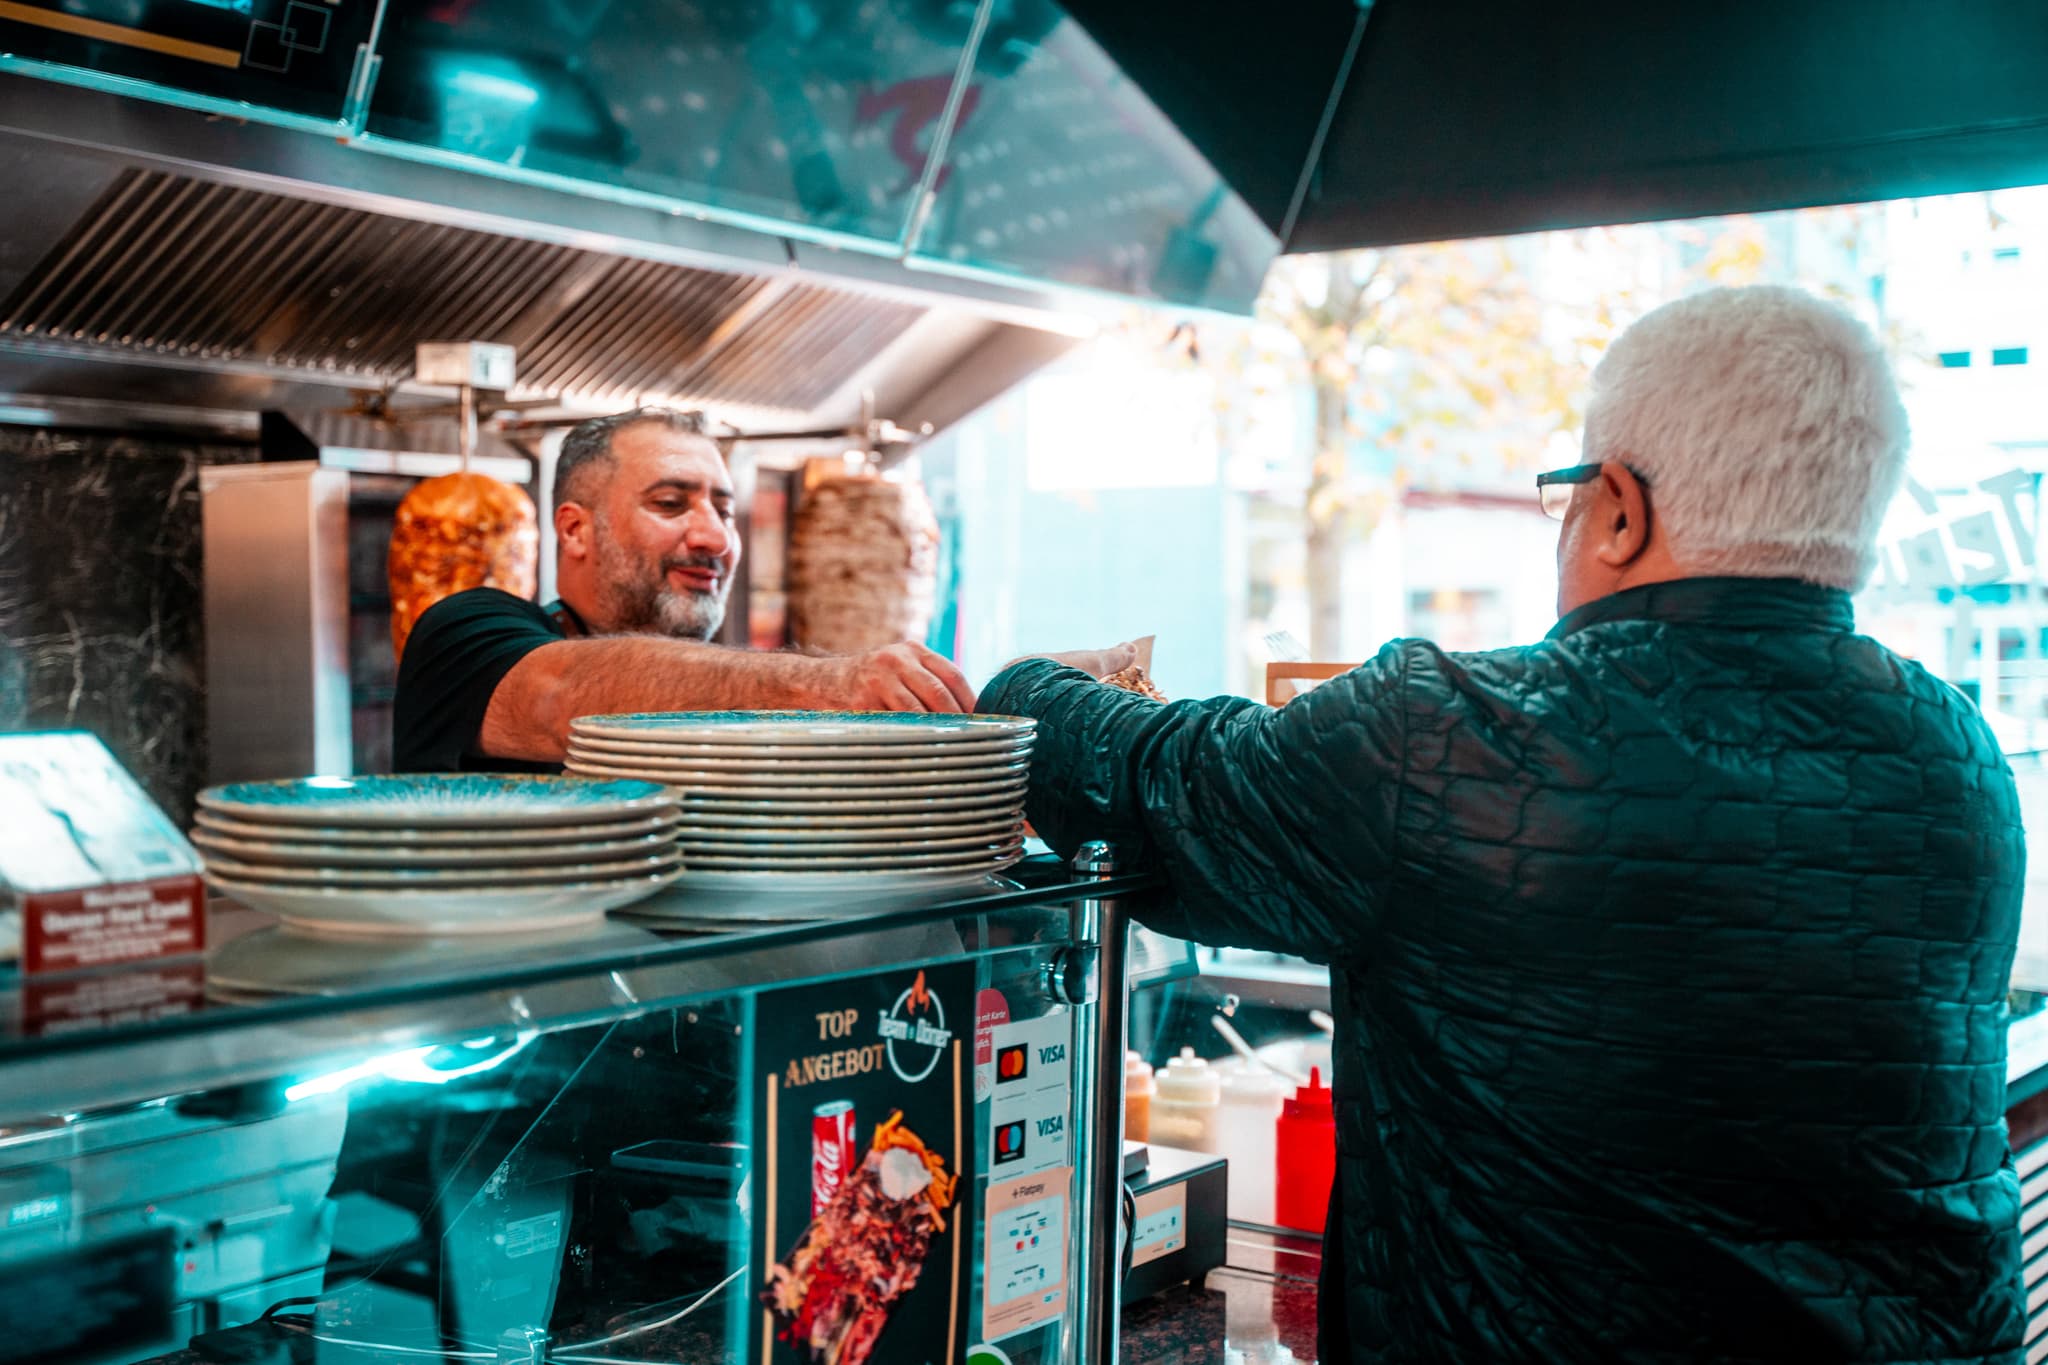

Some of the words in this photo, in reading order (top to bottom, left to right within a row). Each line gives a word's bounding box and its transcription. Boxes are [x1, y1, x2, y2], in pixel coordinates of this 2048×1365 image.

[816, 1008, 859, 1041] TOP
[784, 1043, 886, 1088] ANGEBOT
[1038, 1044, 1065, 1065] VISA
[1036, 1115, 1063, 1136] VISA
